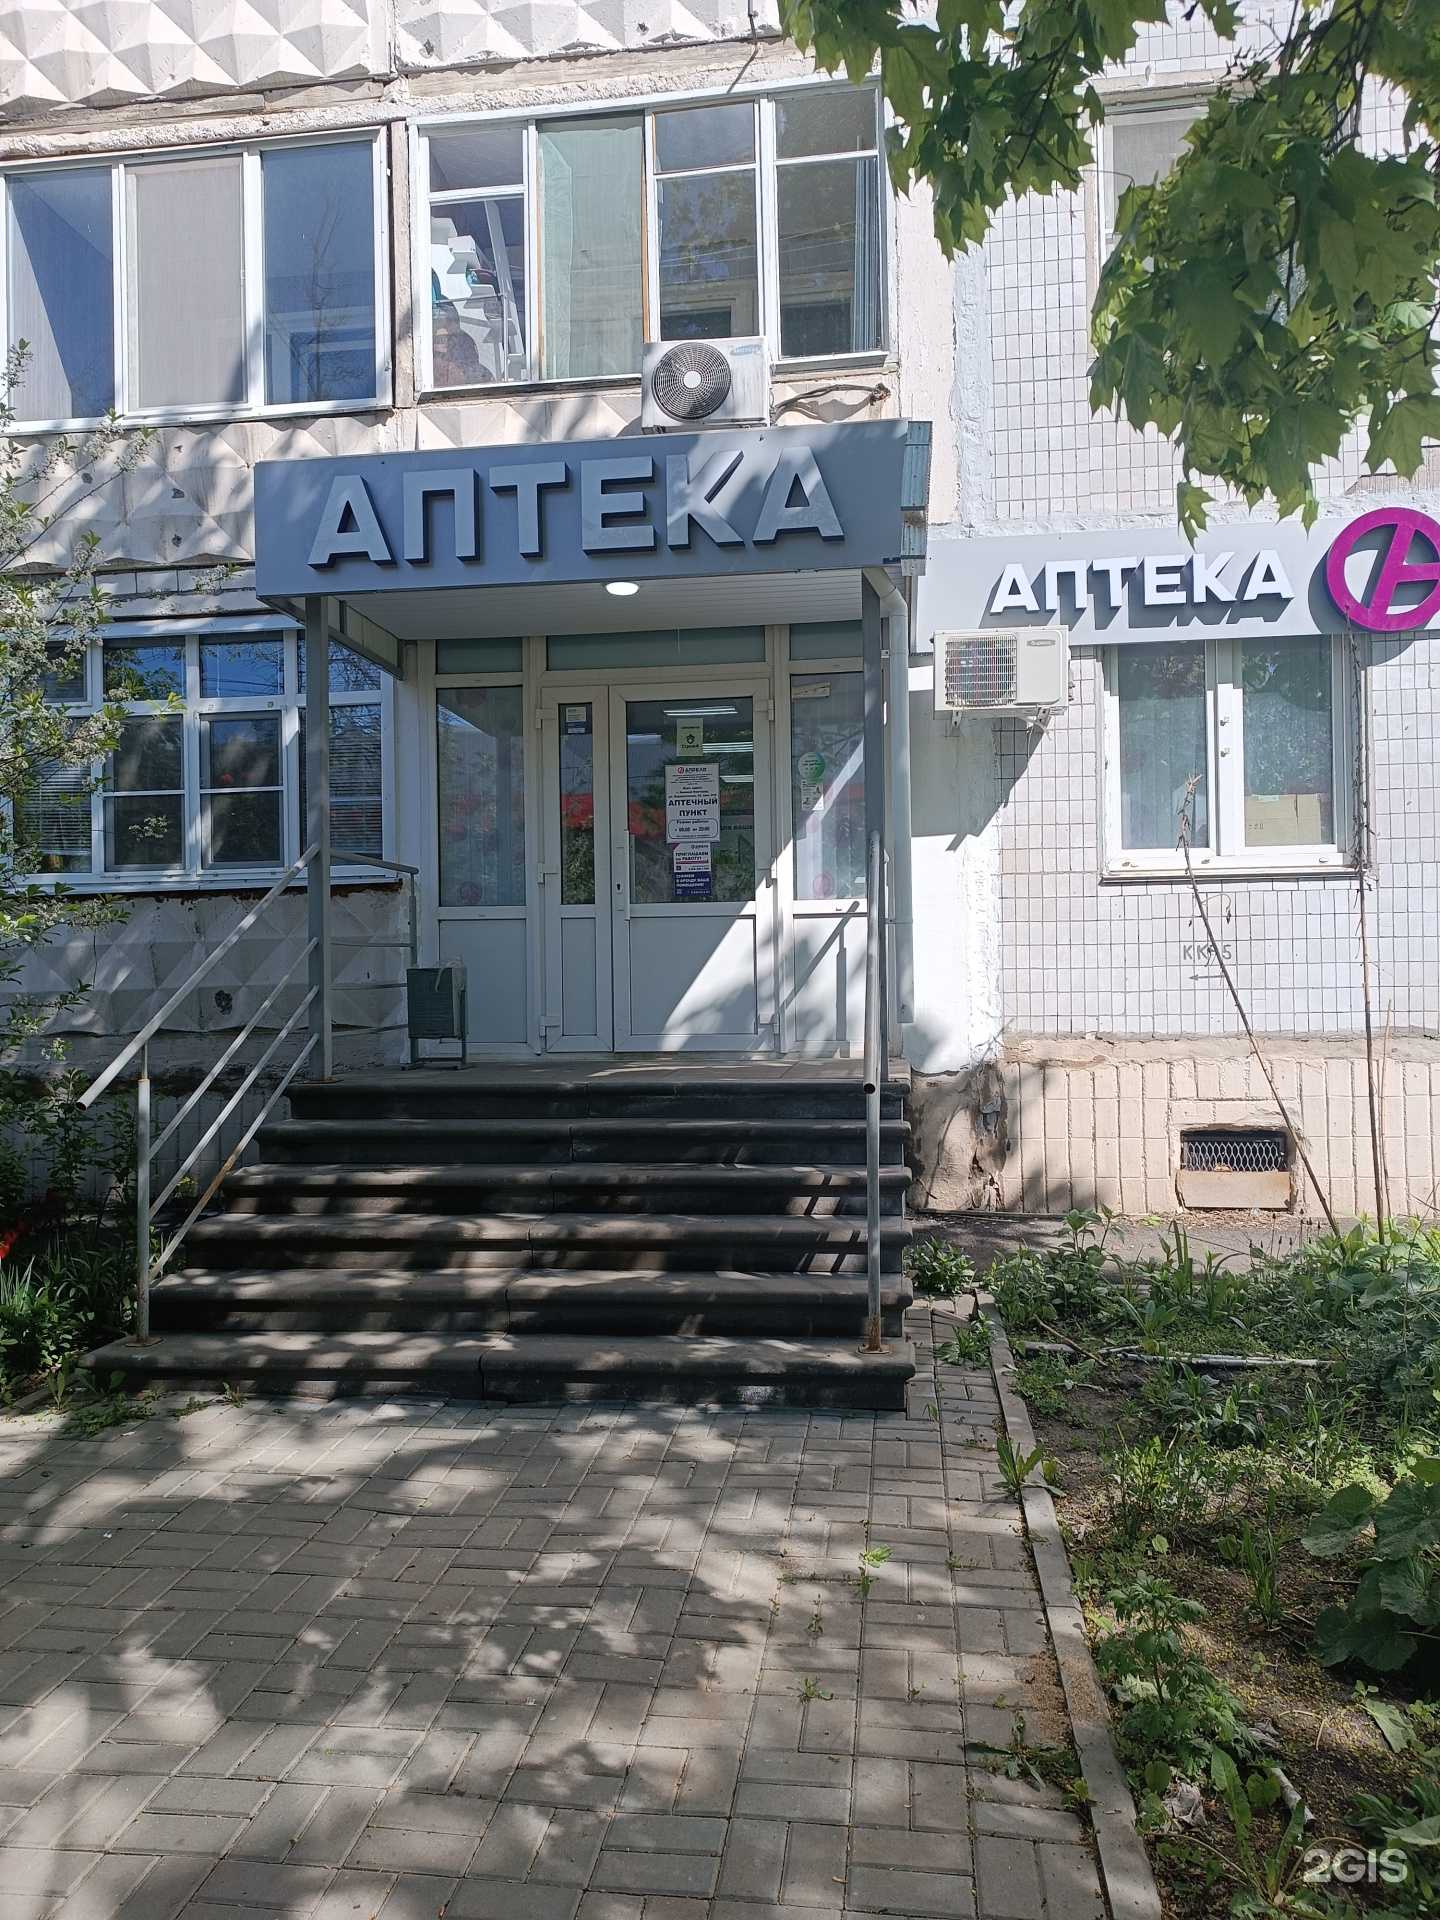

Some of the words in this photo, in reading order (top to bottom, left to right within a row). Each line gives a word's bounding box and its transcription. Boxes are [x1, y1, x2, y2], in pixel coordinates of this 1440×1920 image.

[308, 447, 845, 569] АПТЕКА
[990, 549, 1296, 614] АПТЕКА
[668, 798, 718, 807] АПТЕЧНЫЙ
[679, 809, 707, 817] ПУНКТ
